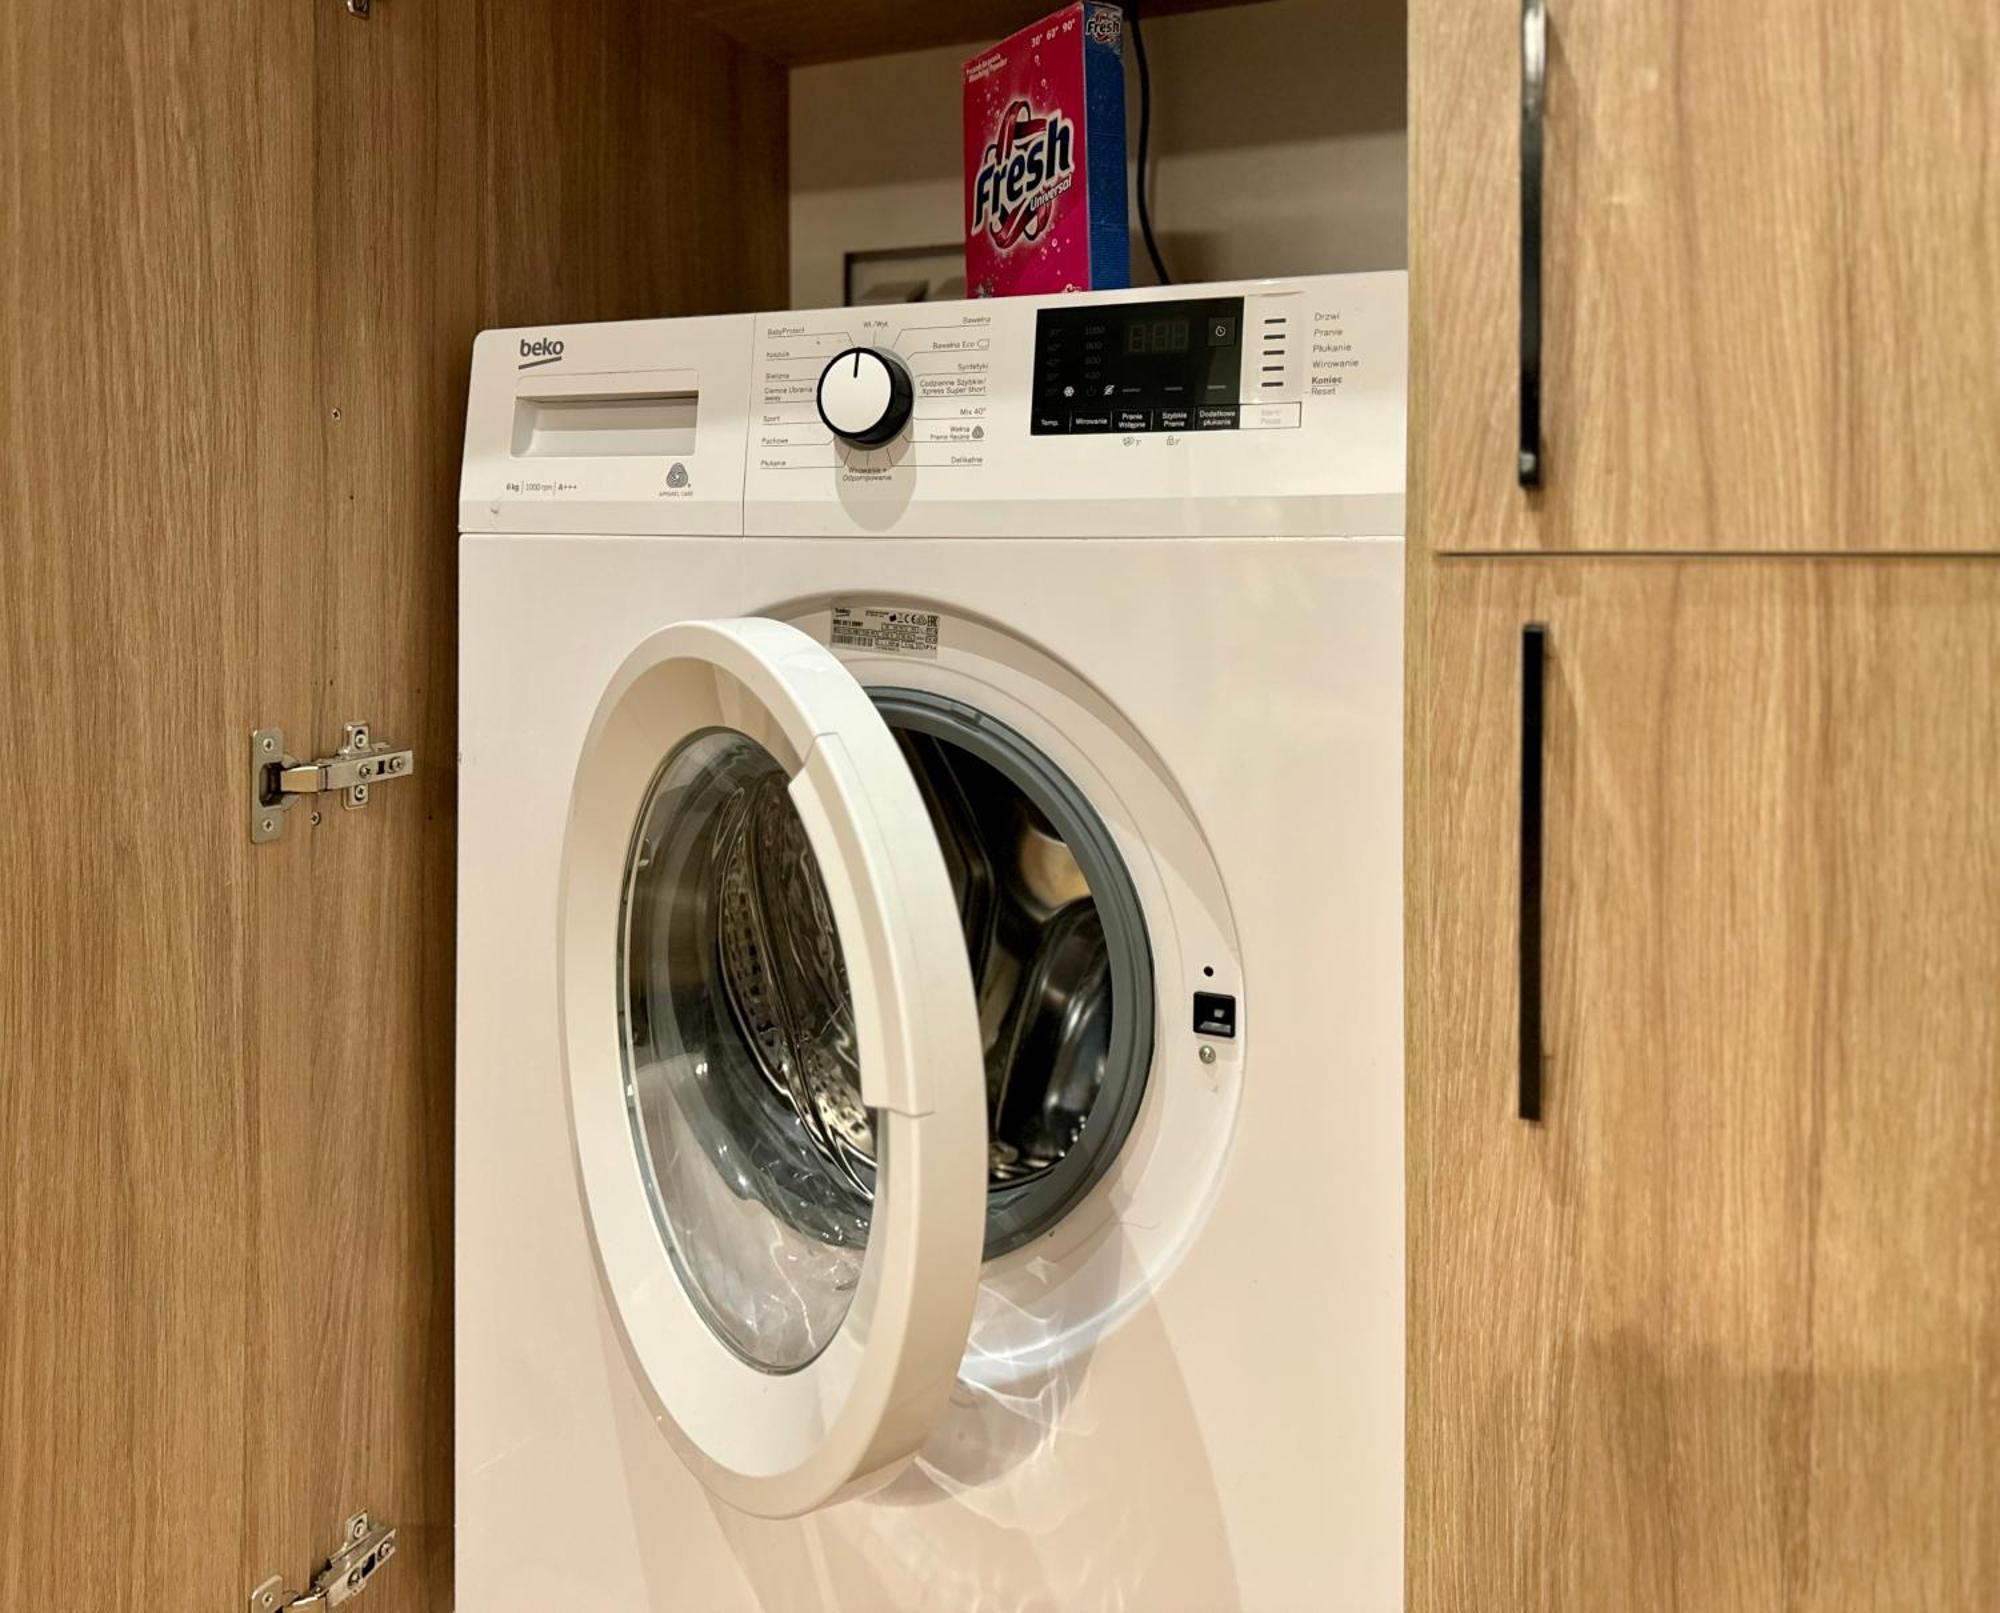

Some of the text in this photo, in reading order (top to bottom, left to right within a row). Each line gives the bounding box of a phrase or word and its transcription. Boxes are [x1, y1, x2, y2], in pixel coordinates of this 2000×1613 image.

[973, 112, 1073, 232] Fresh
[1029, 175, 1073, 211] Universal
[1314, 312, 1340, 321] Drzwi
[1313, 328, 1343, 337] Pranie
[519, 337, 564, 357] beko
[962, 340, 975, 348] Eco
[1313, 344, 1352, 353] Płukanie
[1312, 360, 1359, 369] Wirowanie
[1311, 376, 1343, 385] Koniec
[946, 387, 966, 396] Super
[1311, 387, 1336, 395] Reset
[960, 407, 987, 416] Mix 40°
[1199, 410, 1236, 418] Dodatkowe
